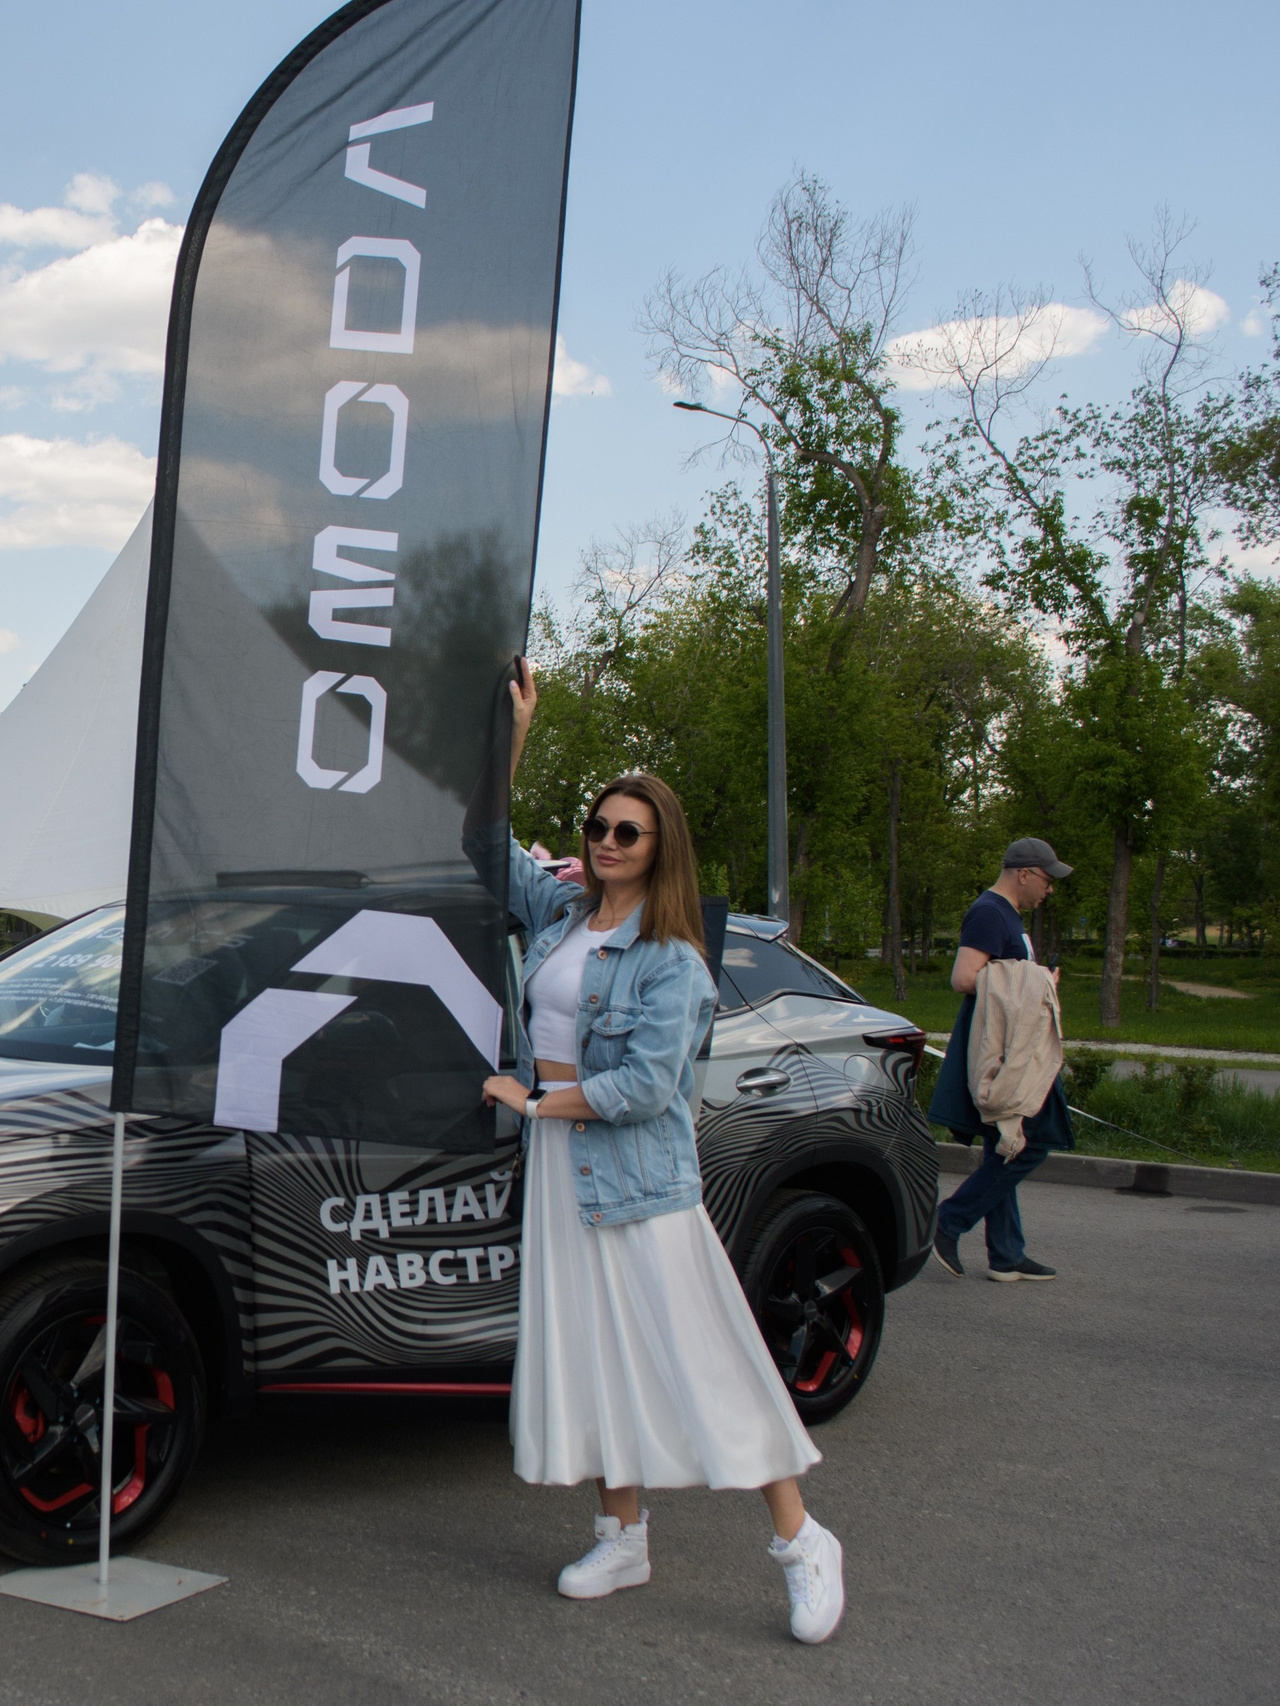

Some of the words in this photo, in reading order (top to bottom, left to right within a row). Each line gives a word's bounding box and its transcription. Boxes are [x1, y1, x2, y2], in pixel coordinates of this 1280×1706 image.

[296, 101, 435, 795] OMODA
[320, 1170, 513, 1241] СДЕЛАЙ
[326, 1245, 521, 1294] НАВСТР
